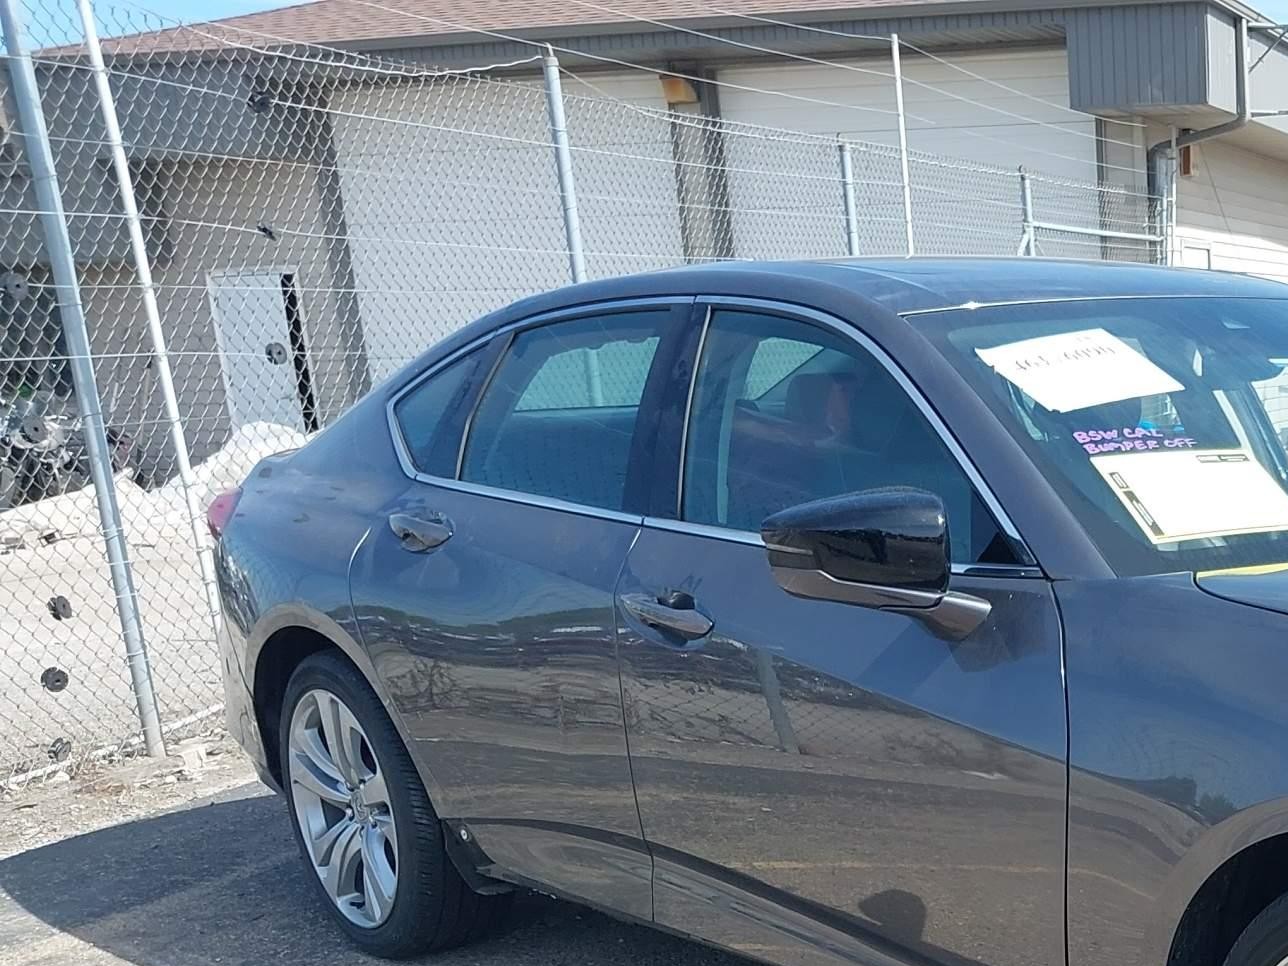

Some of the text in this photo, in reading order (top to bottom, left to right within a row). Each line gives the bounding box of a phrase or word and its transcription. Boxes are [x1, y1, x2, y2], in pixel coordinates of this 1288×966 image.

[1073, 429, 1118, 444] BSW
[1083, 438, 1198, 454] BUMPER OFF
